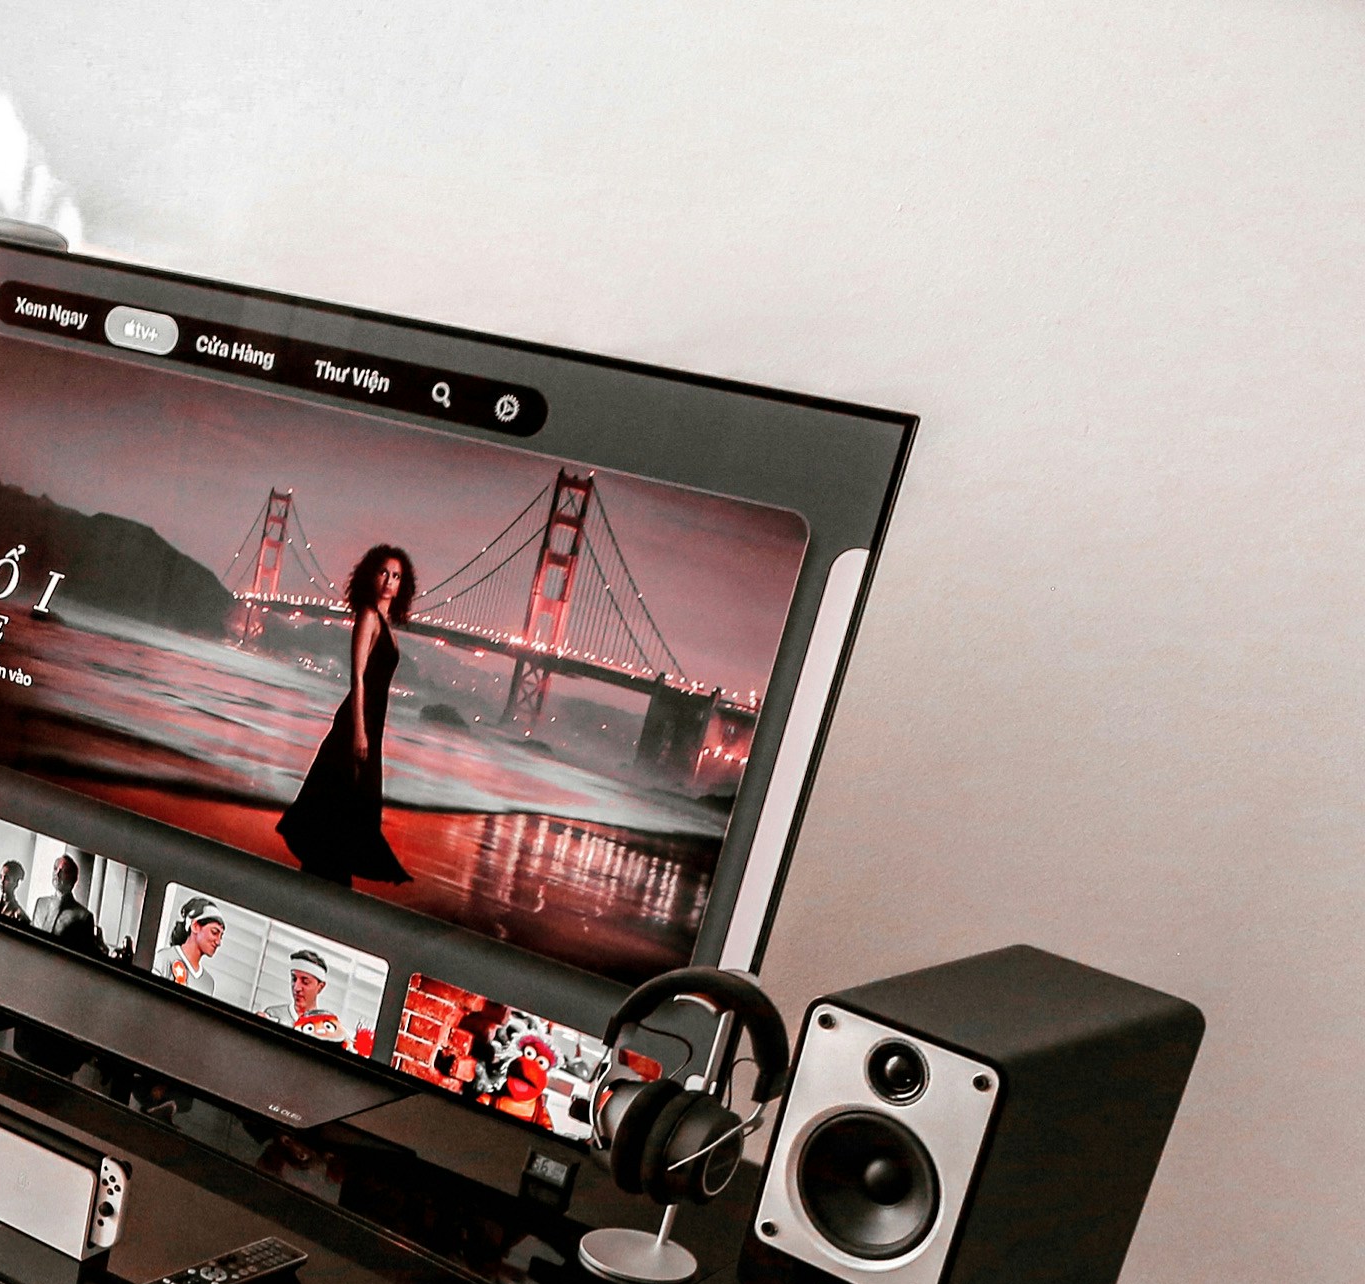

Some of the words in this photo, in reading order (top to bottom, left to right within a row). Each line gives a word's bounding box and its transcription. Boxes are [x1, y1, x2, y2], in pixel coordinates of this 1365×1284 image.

[14, 297, 47, 319] Xem
[49, 306, 88, 330] Ngay
[195, 334, 229, 358] Cửa
[315, 359, 350, 383] Thư
[351, 367, 390, 394] Viện
[8, 668, 33, 688] vào
